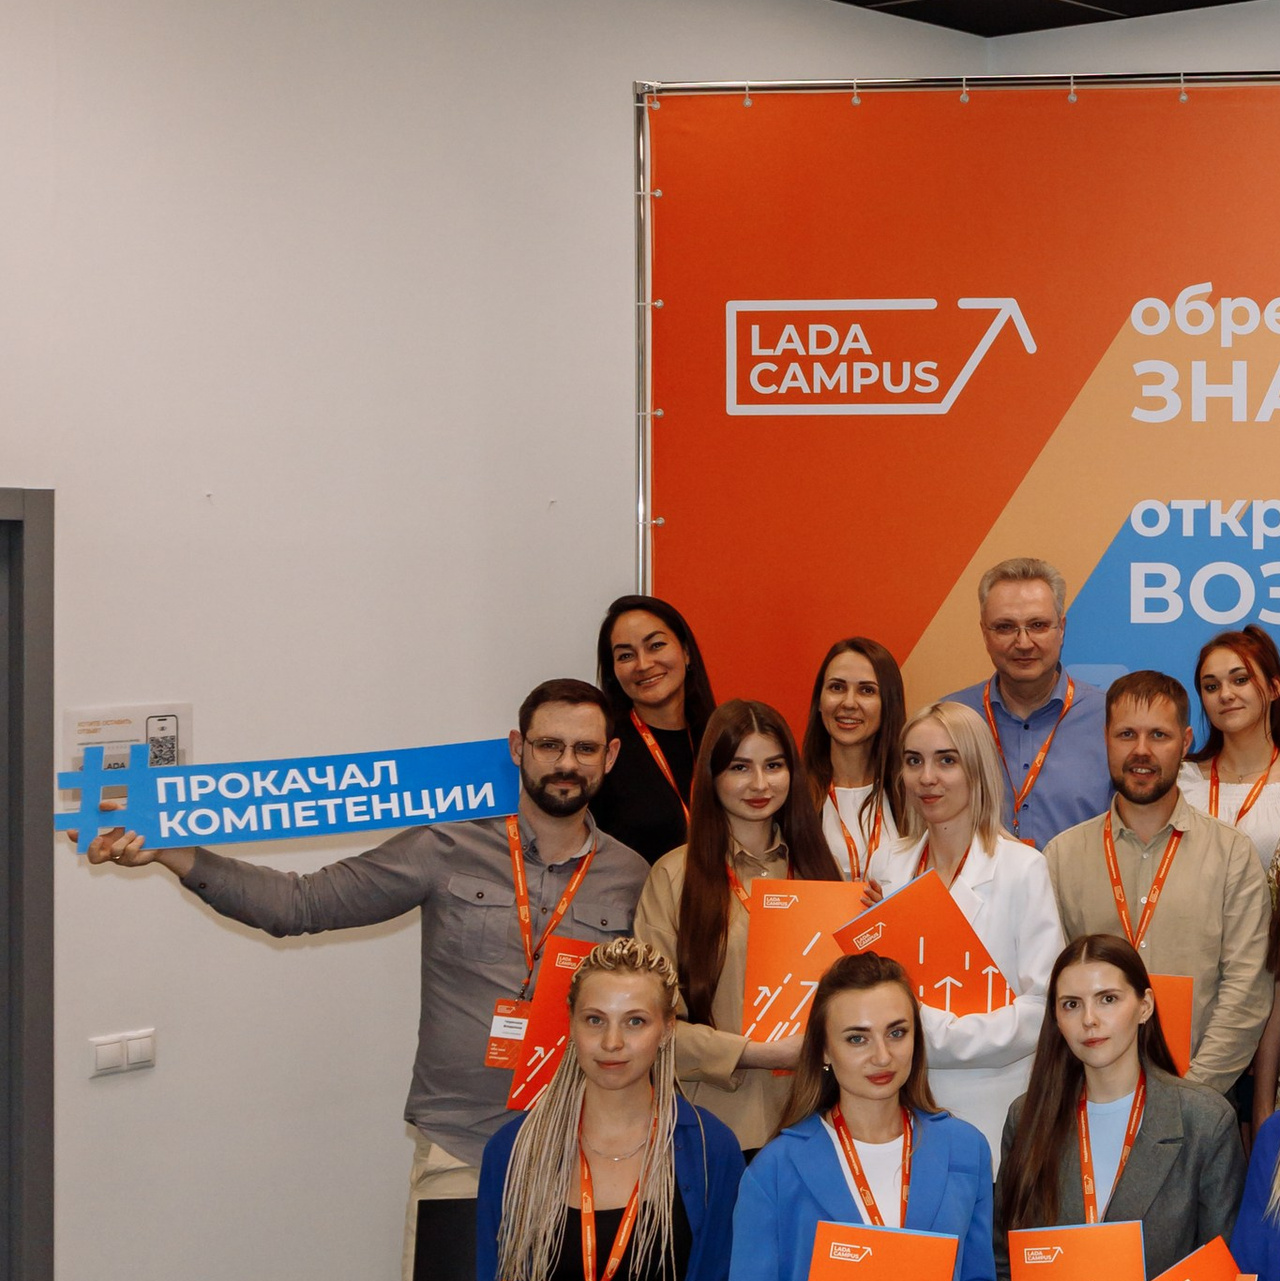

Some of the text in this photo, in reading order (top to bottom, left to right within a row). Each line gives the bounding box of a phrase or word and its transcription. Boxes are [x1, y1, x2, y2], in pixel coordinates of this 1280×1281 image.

[750, 324, 872, 355] LADA
[749, 361, 939, 394] CAMPUS
[155, 759, 399, 804] ПРОКАЧАЛ
[157, 781, 497, 838] КОМПЕТЕНЦИИ
